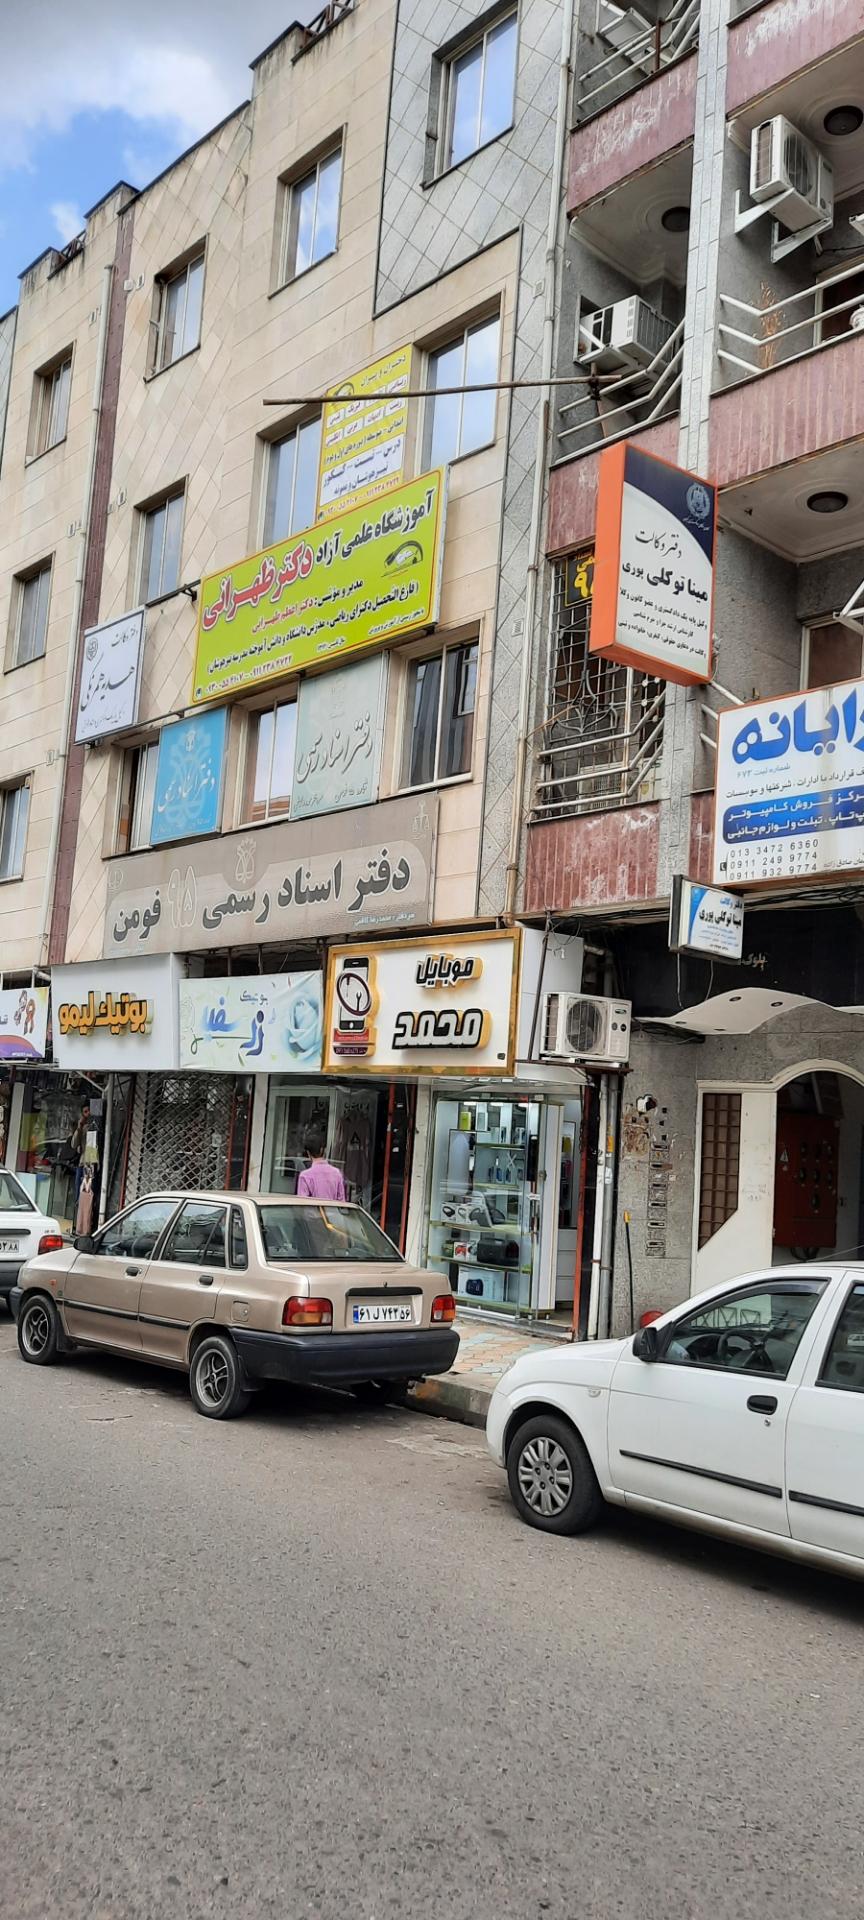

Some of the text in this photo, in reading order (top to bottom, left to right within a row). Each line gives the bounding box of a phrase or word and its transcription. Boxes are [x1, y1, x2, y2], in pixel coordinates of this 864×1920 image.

[323, 438, 401, 488] درس تست کنکور
[351, 462, 388, 490] تیزهوشان
[374, 488, 434, 538] آموزشگاه
[316, 532, 341, 566] آزاد
[342, 523, 373, 559] علمی
[635, 529, 683, 559] دفتر وکالت
[272, 541, 314, 602] دکتر
[622, 562, 644, 580] پوری
[346, 579, 363, 596] مدیر
[646, 566, 685, 596] توکلی
[688, 578, 709, 604] مینا
[297, 598, 313, 615] دکتر
[350, 599, 372, 620] دکترای
[286, 625, 306, 642] دانشگاه
[697, 619, 708, 631] وکیل
[296, 711, 374, 784] دفتر اسناد رسمی
[753, 767, 769, 777] ثبت
[769, 763, 790, 775] شماره
[820, 772, 828, 781] با
[829, 769, 855, 783] قرارداد
[798, 775, 819, 788] ادارات
[728, 801, 789, 822] کامپیوتر
[790, 796, 833, 813] فروش
[759, 819, 790, 835] لوازم
[797, 815, 823, 828] تبلت
[730, 838, 819, 859] 013 3472 6360
[730, 850, 817, 870] 0911 249 9774
[729, 862, 817, 881] 0911 932 9774
[113, 846, 411, 943] دفتر اسناد رسمی ۹۵ فومن
[733, 913, 743, 930] مینا
[416, 953, 475, 987] موبایل
[240, 990, 268, 1006] بوتیک
[58, 990, 149, 1036] بوتیک لیمو
[392, 1008, 484, 1050] محمد
[9, 1243, 18, 1251] ۸۸
[360, 1307, 371, 1321] ۶۱
[373, 1307, 380, 1321] ل
[400, 1308, 411, 1321] ۵۶
